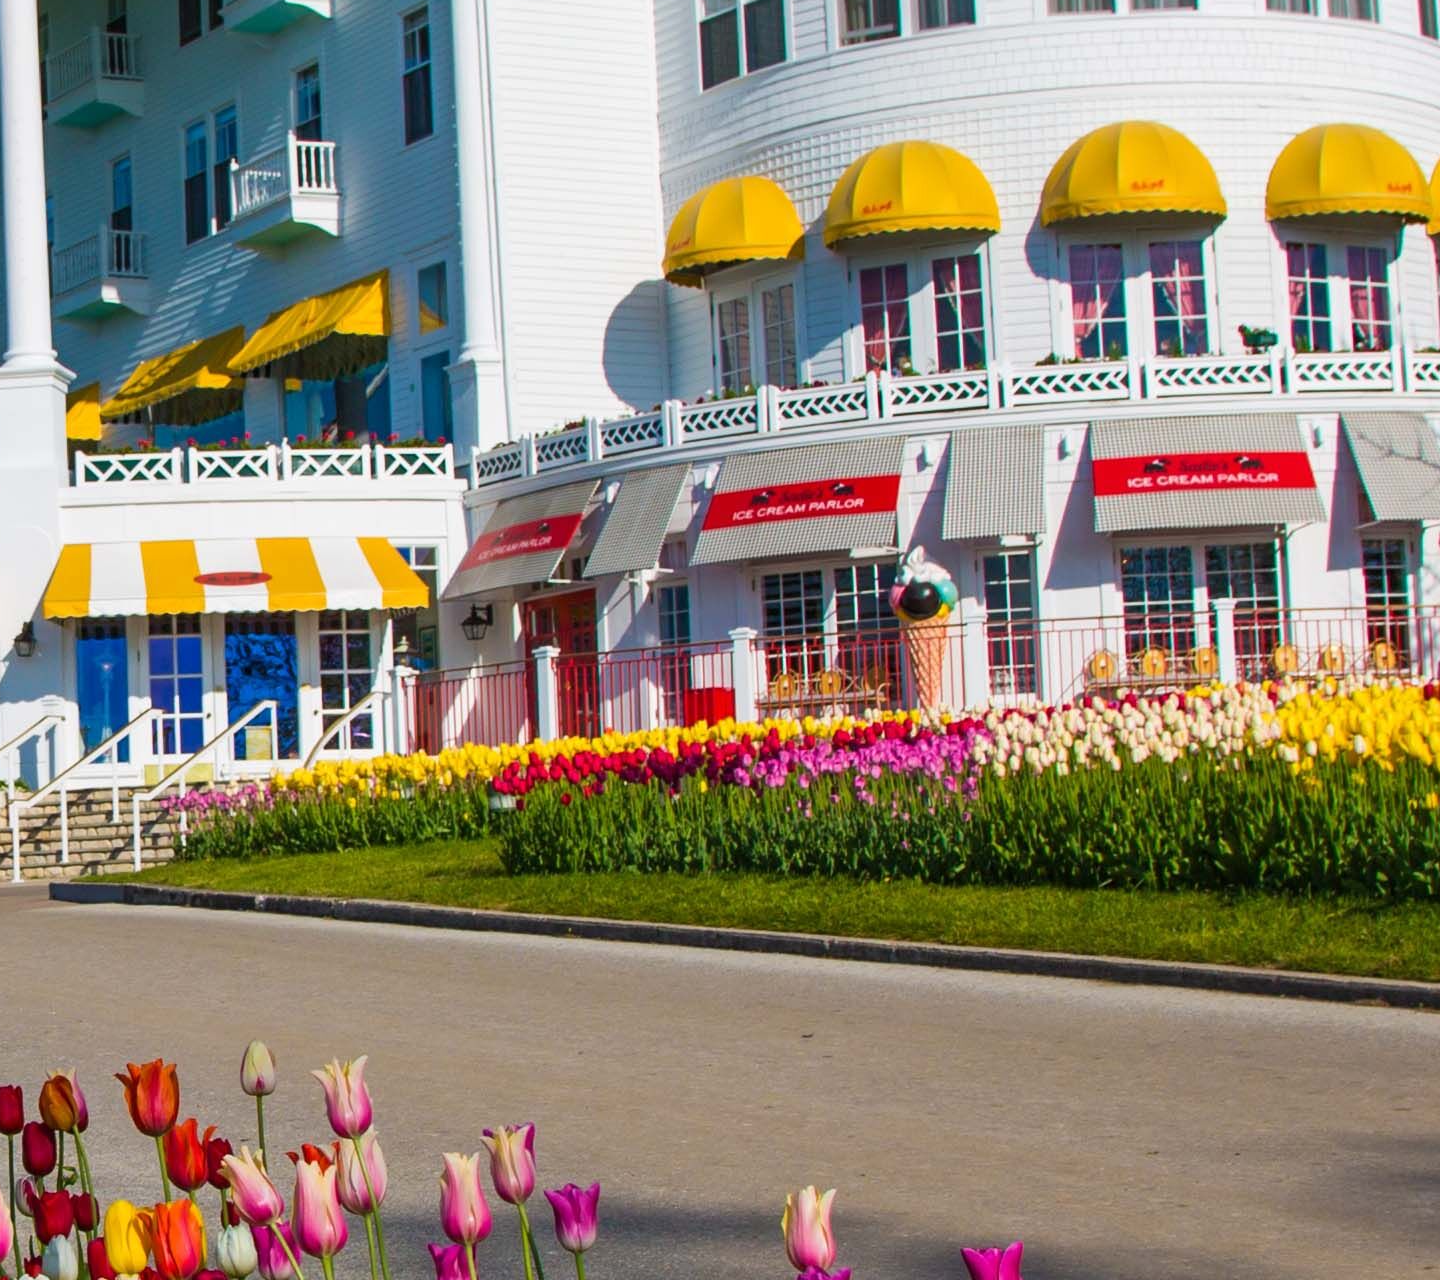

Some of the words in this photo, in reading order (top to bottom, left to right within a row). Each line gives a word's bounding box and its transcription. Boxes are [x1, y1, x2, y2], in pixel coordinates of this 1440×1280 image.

[1127, 477, 1153, 488] ICE
[1156, 474, 1214, 486] CREAM
[1217, 472, 1279, 484] PARLOR
[732, 510, 754, 521] ICE
[756, 504, 805, 517] CREAM
[808, 497, 865, 512] PARLOR
